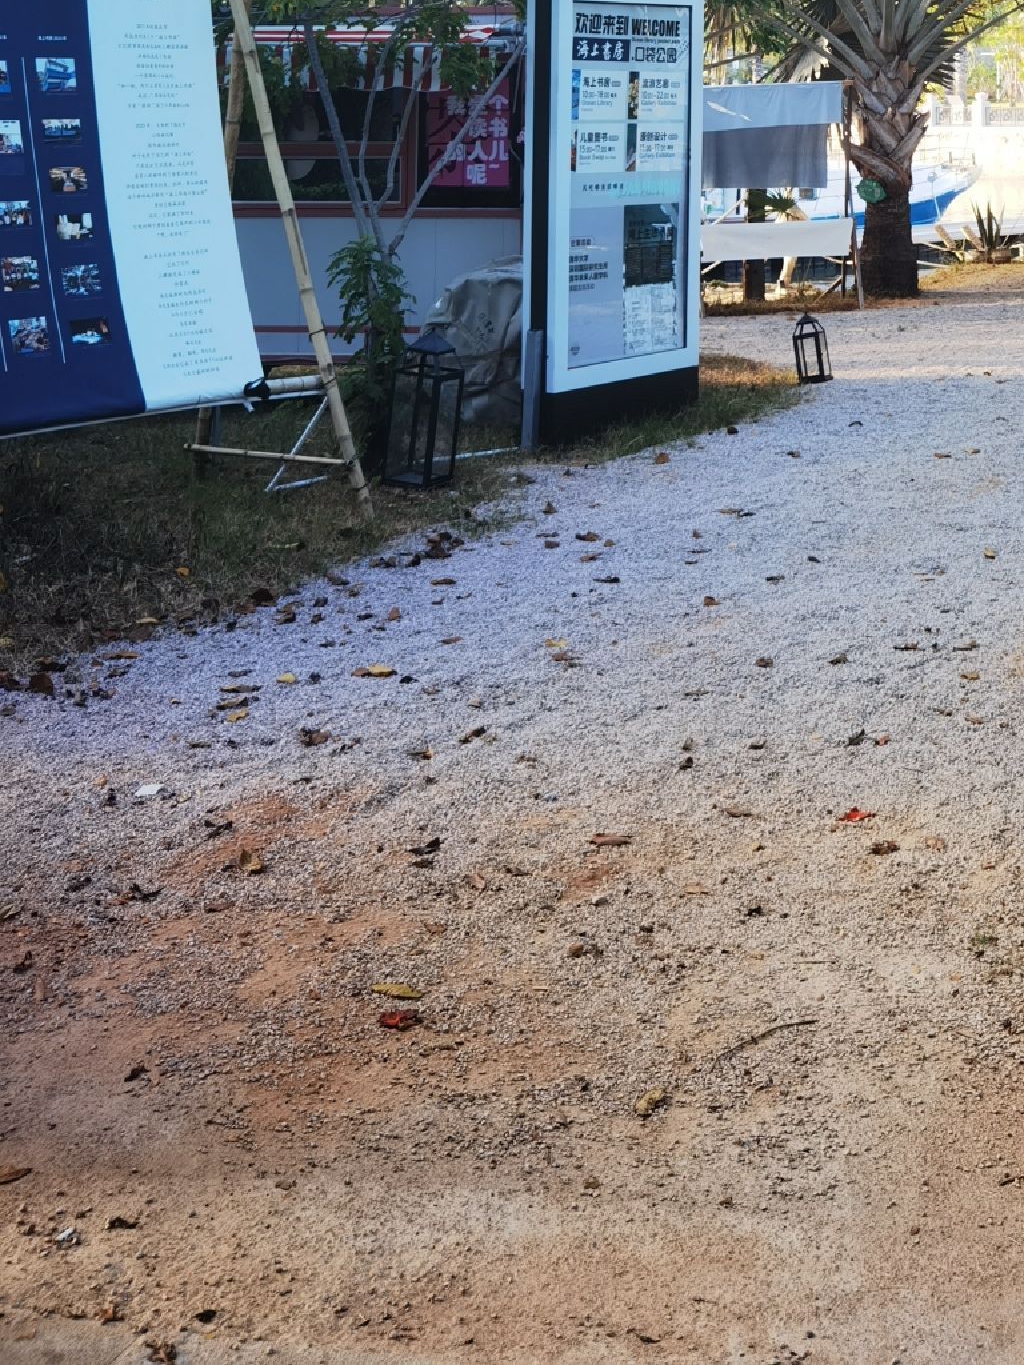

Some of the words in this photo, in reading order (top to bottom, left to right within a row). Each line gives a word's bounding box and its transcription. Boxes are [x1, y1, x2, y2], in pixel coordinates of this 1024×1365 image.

[575, 12, 629, 35] 欢迎来到
[631, 18, 681, 37] WELCOME
